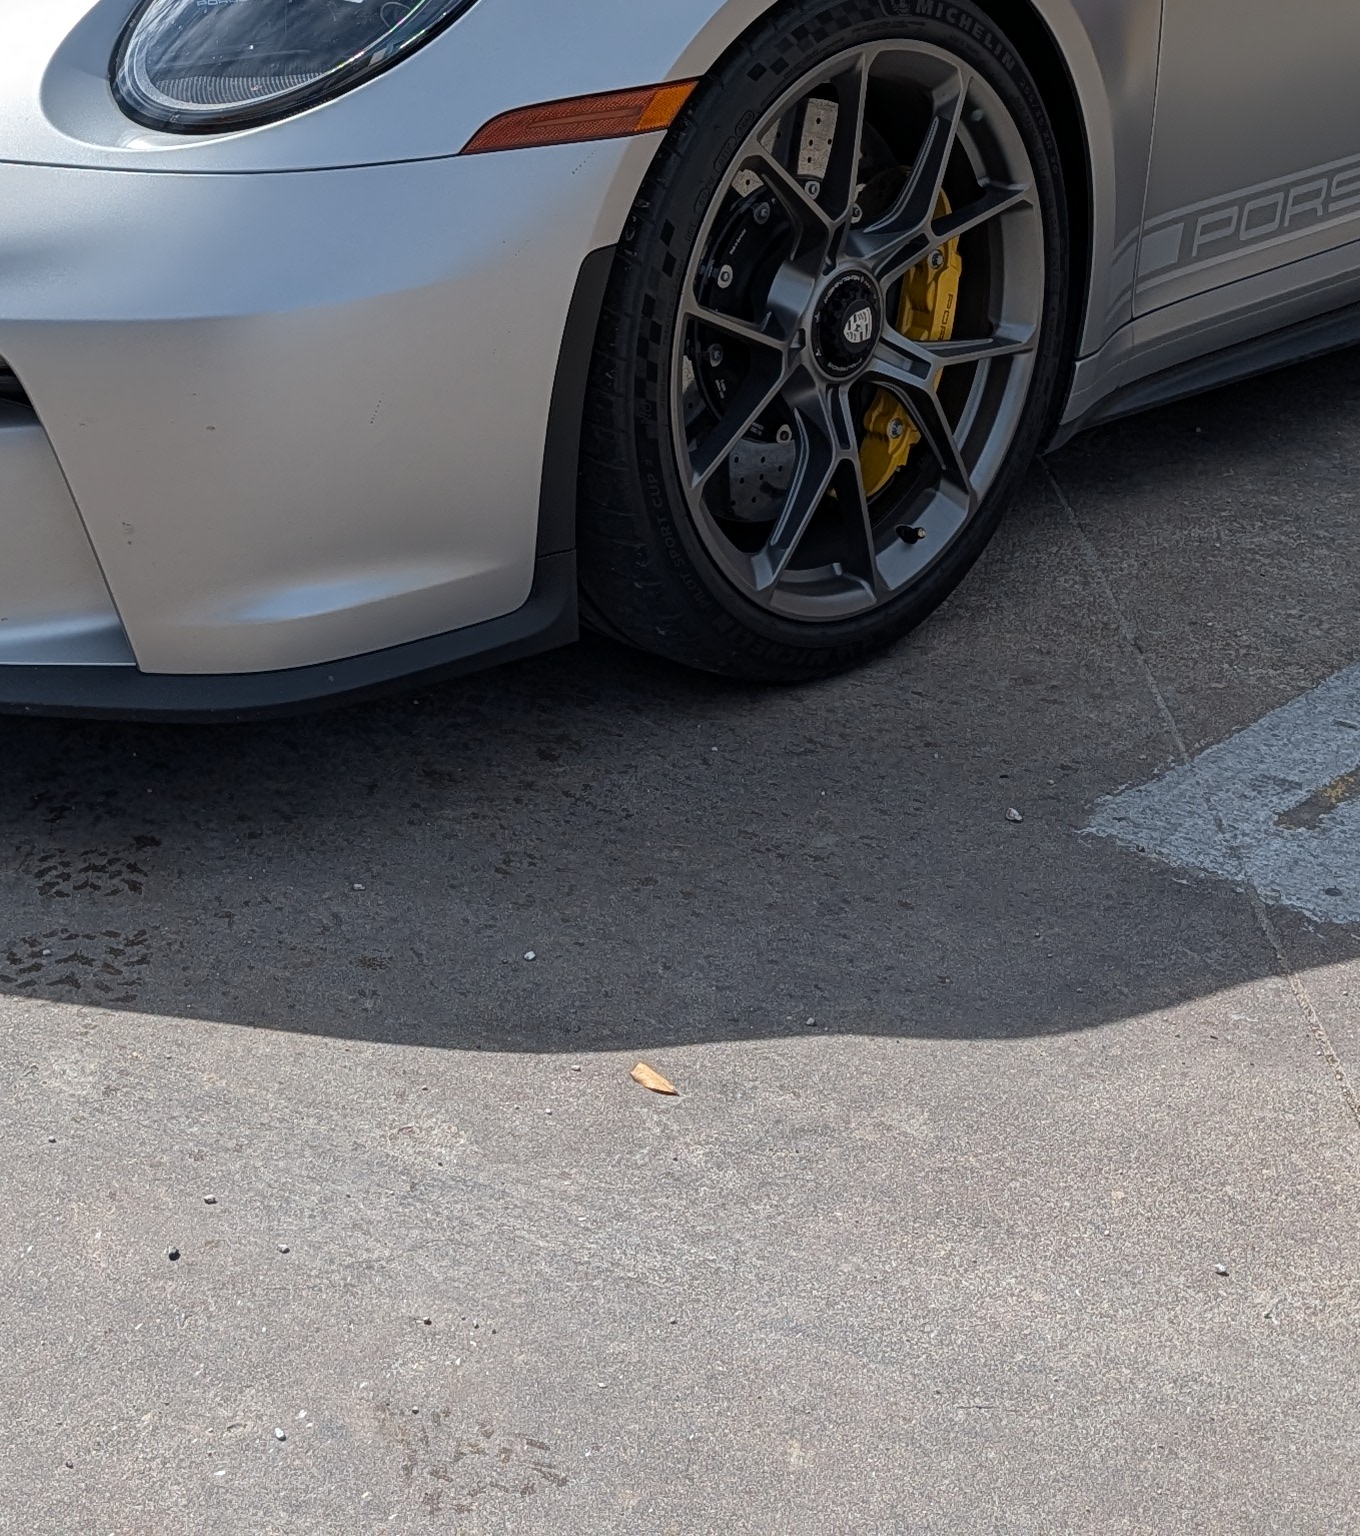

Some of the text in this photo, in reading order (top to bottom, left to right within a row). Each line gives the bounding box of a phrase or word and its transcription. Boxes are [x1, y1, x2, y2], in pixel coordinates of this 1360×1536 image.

[647, 473, 664, 508] CUP
[657, 516, 685, 568] SPORT
[681, 573, 712, 610] PILOT
